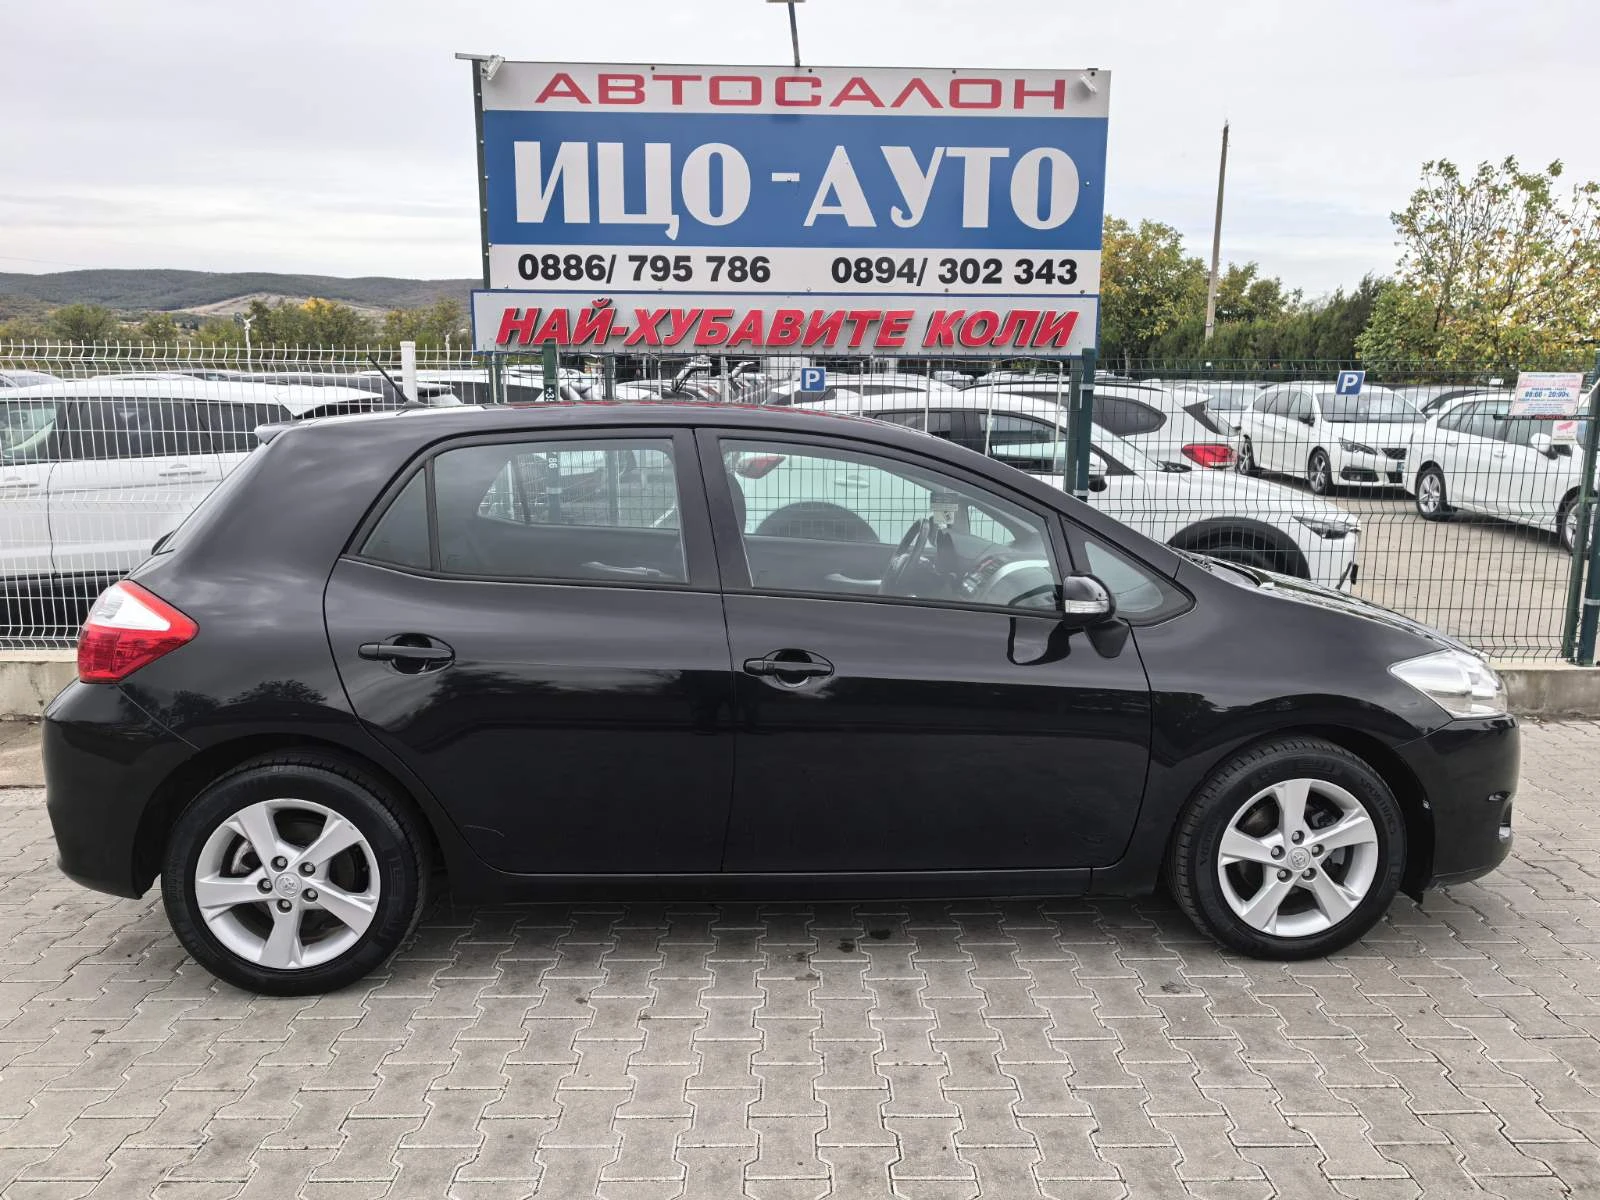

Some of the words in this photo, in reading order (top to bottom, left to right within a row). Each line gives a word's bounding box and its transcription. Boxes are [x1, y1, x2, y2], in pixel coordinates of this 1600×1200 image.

[534, 72, 1067, 110] АВТОСАЛОН
[513, 140, 752, 241] ИЦО
[803, 144, 1080, 230] АУТО
[517, 252, 617, 284] 0886/
[627, 254, 694, 282] 795
[705, 255, 771, 283] 786
[831, 256, 928, 286] 0894/
[937, 257, 1003, 285] 302
[1013, 258, 1078, 285] 343
[495, 297, 915, 348] НАЙ-ХУБАВИТЕ
[921, 309, 1080, 348] КОЛИ
[805, 370, 820, 389] P
[1341, 373, 1359, 393] P
